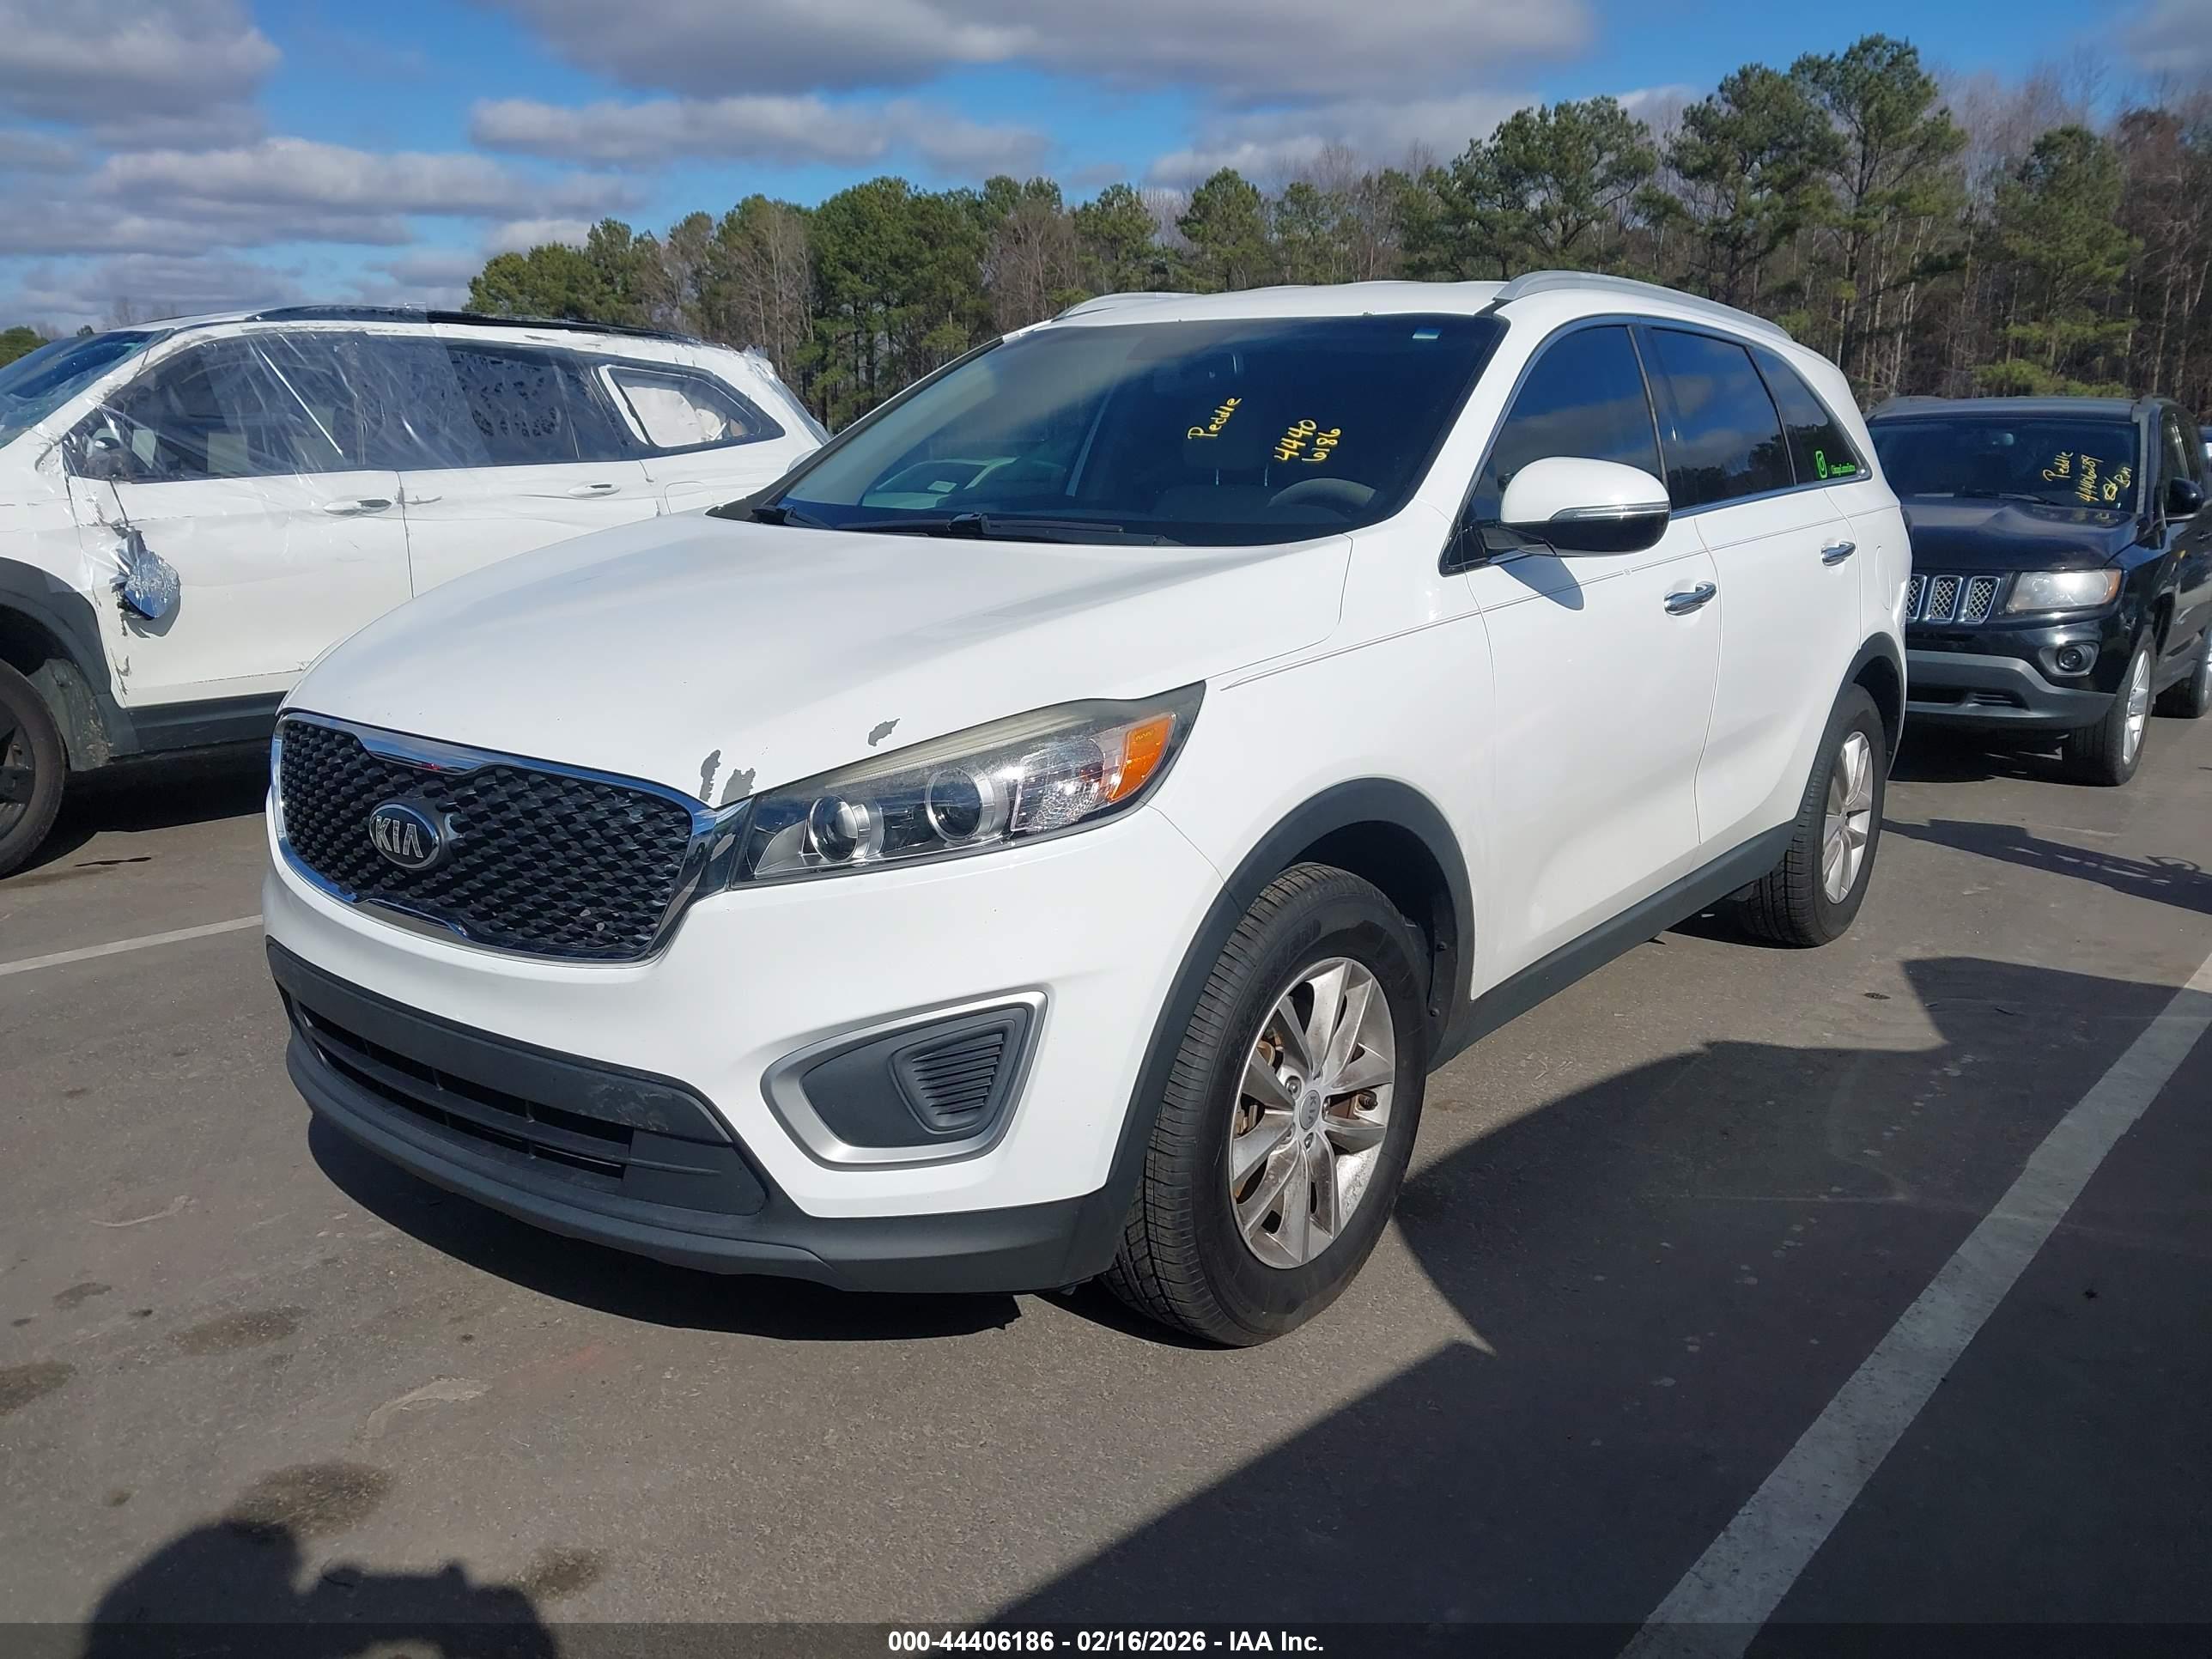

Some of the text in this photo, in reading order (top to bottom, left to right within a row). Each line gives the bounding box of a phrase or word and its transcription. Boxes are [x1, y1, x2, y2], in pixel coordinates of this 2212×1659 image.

[1273, 419, 1317, 461] 4440
[1302, 428, 1341, 462] 6186
[375, 815, 424, 859] KIA
[1308, 1096, 1317, 1124] KIA
